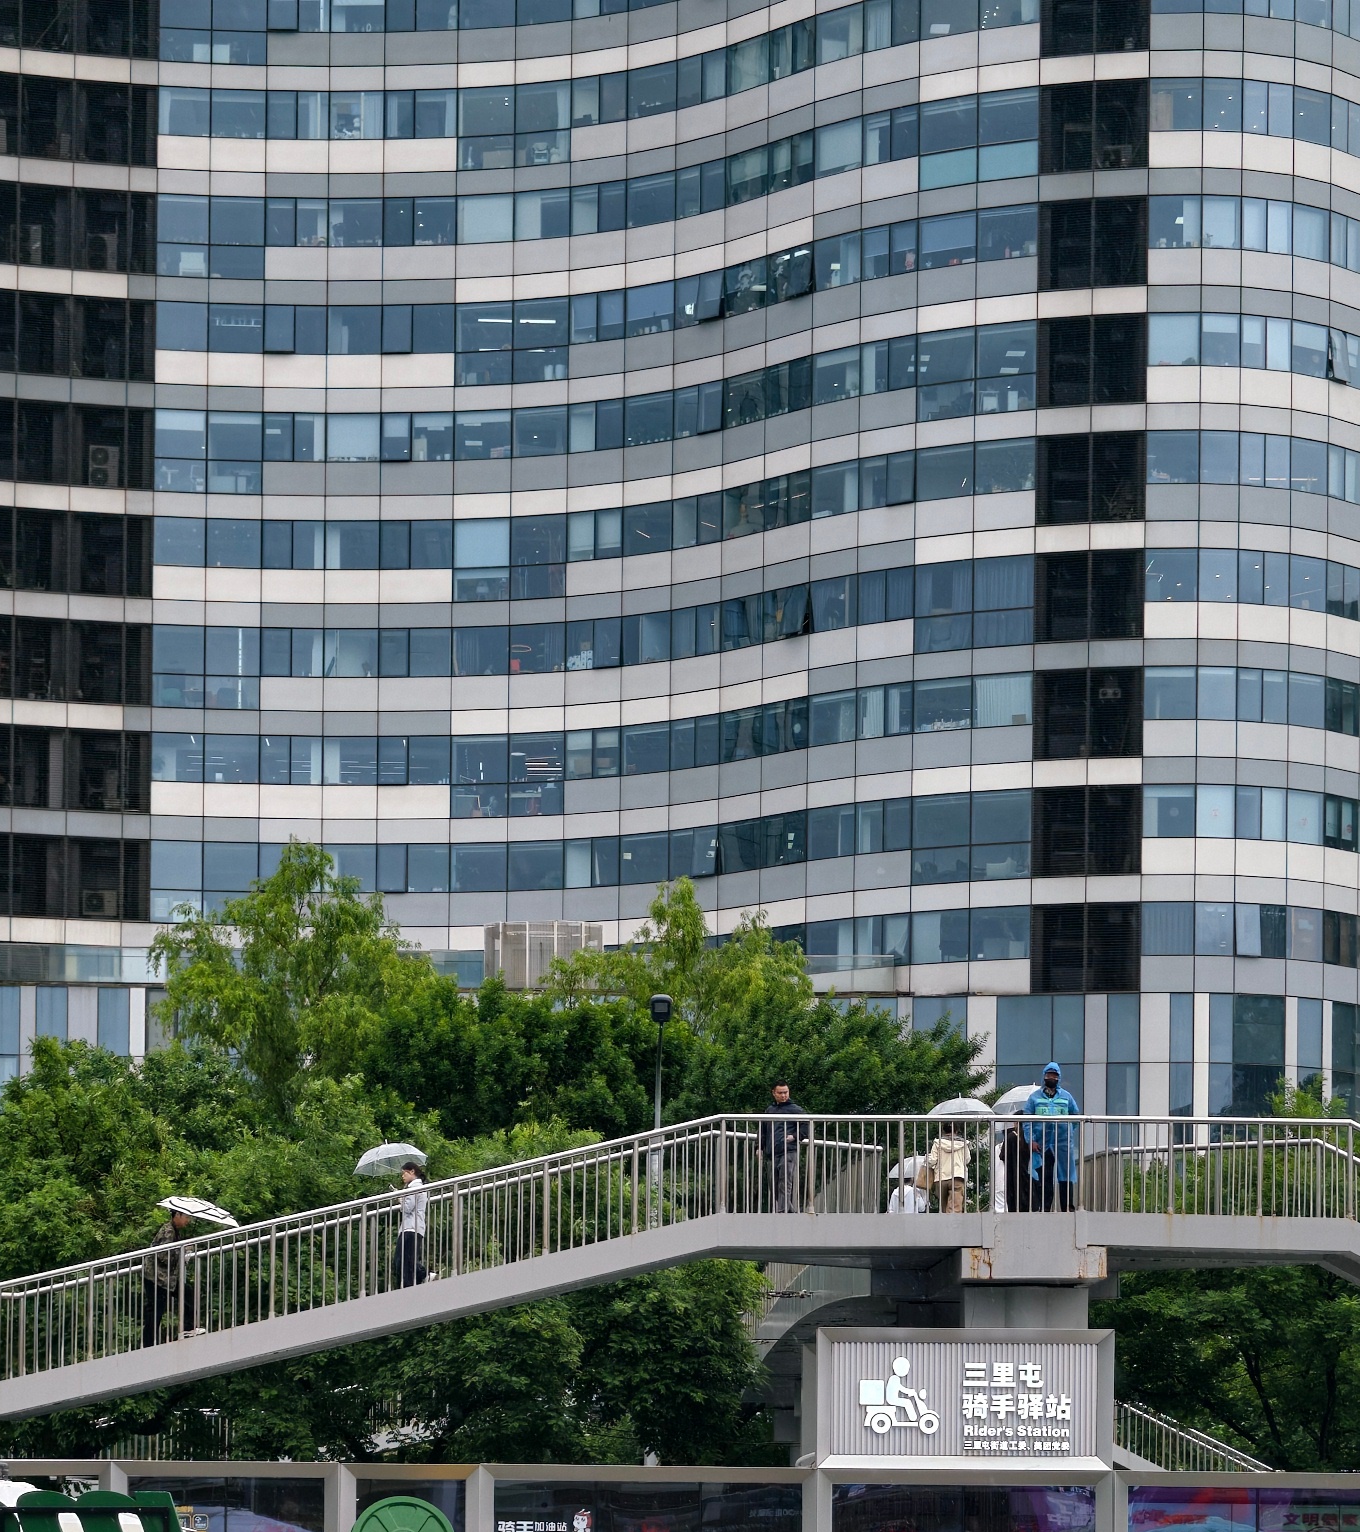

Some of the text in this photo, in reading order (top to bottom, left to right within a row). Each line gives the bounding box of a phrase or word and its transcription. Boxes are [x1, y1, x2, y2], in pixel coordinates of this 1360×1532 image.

[963, 1362, 1044, 1388] 三里屯
[962, 1392, 1071, 1420] 骑手驿站
[964, 1424, 1070, 1437] Rider's Station
